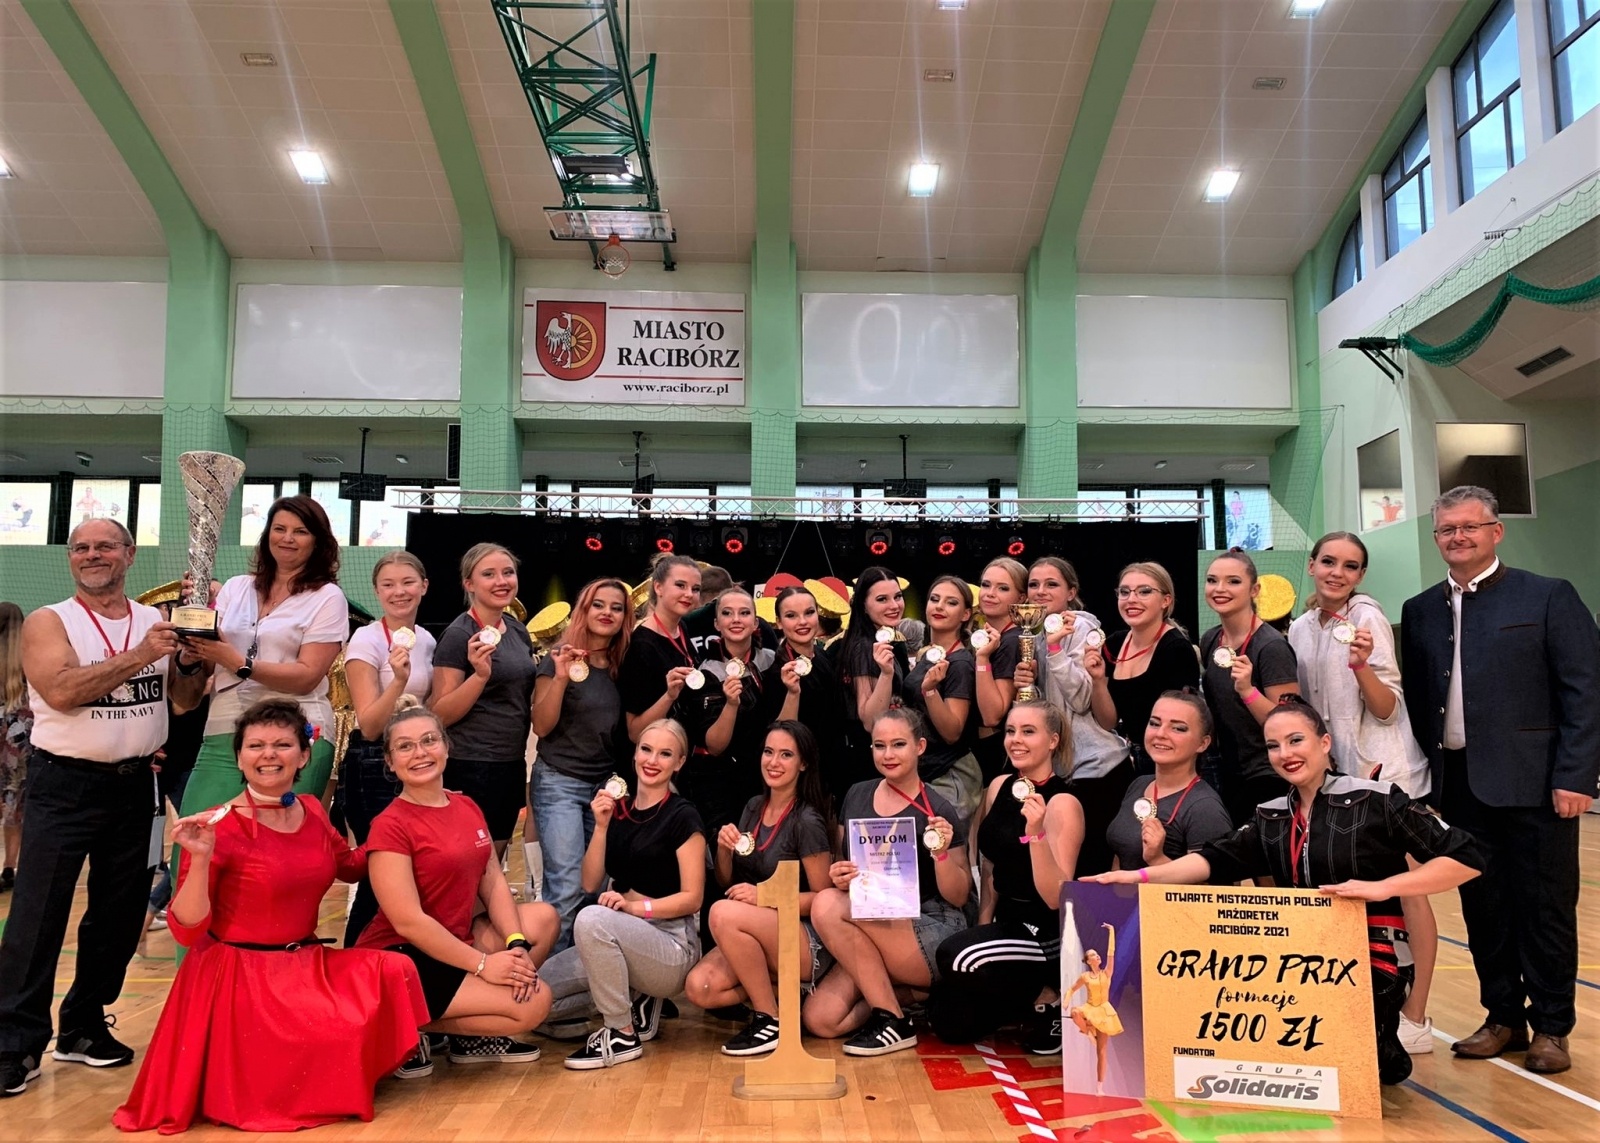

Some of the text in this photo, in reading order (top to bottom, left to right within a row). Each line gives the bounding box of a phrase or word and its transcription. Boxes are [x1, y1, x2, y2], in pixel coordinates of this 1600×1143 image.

[633, 320, 725, 341] MIASTO
[617, 344, 740, 368] RACIBÓRZ
[623, 383, 729, 395] www.raciborz.pl
[91, 706, 154, 719] IN THE NAVY
[859, 834, 907, 845] DYPLOM
[1165, 892, 1332, 907] OTWARTE MISTRZOSTWA POLSKI
[1217, 908, 1279, 921] MAŻORETEK
[1209, 923, 1289, 937] RACIBÓRZ 2021
[1156, 949, 1358, 987] GRAND PRIX
[1215, 986, 1299, 1012] formacje
[1196, 1011, 1267, 1043] 1500
[1173, 1047, 1215, 1057] FUNDATOR
[1236, 1064, 1322, 1077] GRUPA
[1187, 1074, 1319, 1101] Solidaris
